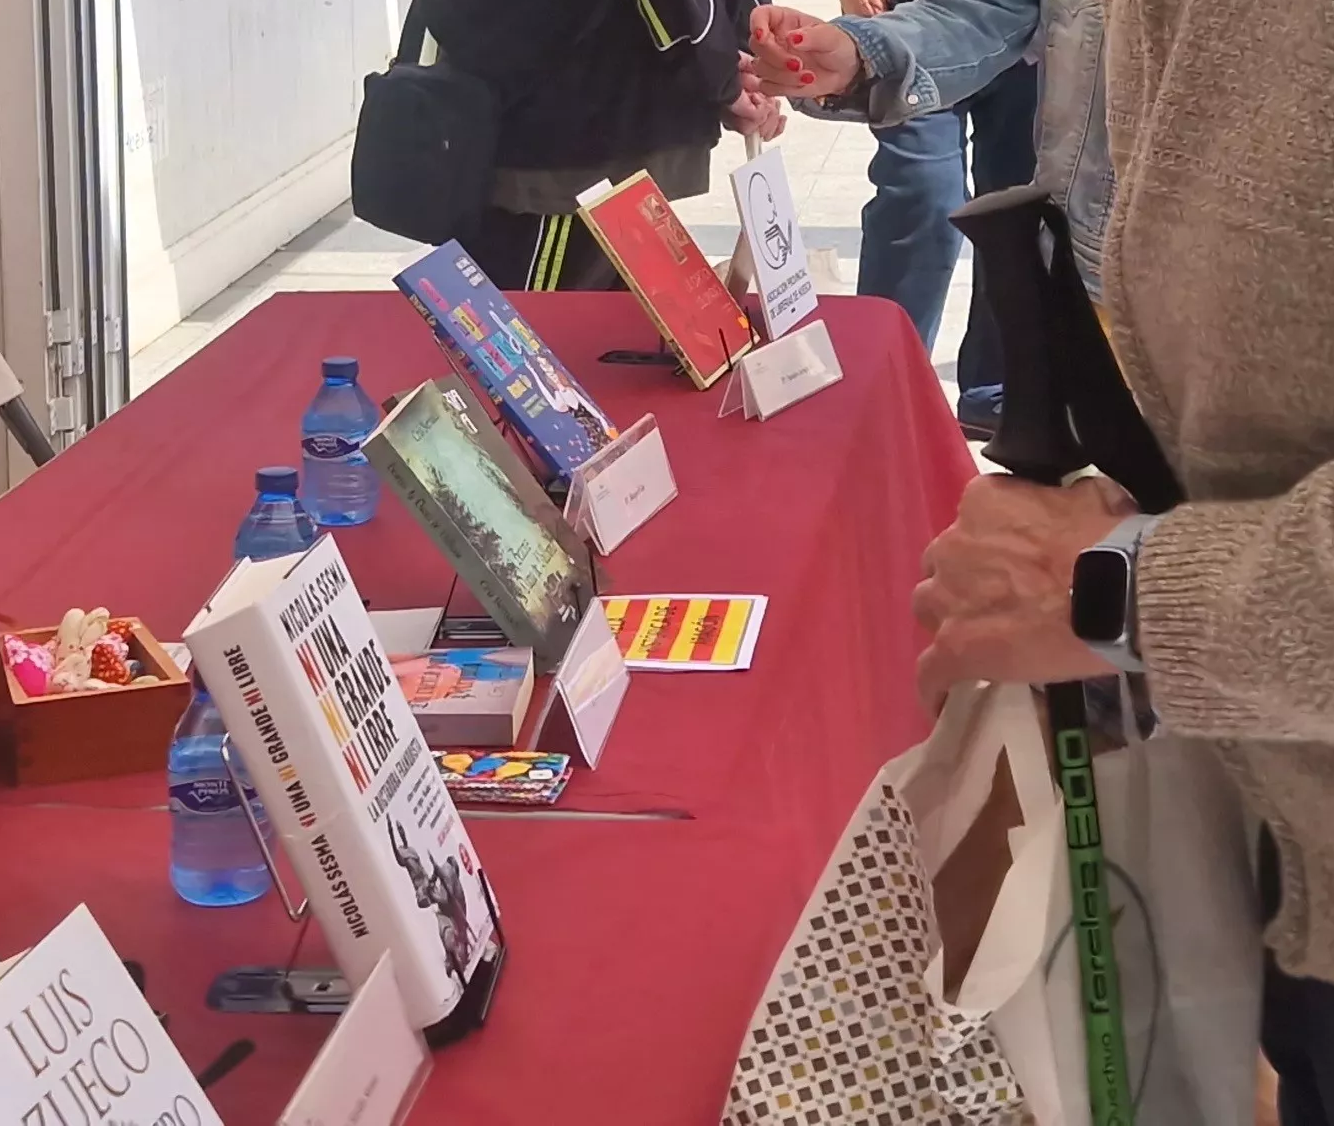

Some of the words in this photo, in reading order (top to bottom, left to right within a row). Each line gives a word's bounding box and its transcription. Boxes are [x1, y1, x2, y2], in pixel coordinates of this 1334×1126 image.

[279, 582, 323, 643] NICOLÁS
[316, 558, 348, 605] SESMA
[223, 644, 257, 695] LIBRE
[295, 638, 328, 697] NI
[310, 613, 352, 679] UNA
[243, 689, 264, 708] NI
[334, 638, 392, 730] GRANDE
[250, 701, 290, 764] GRANDE
[319, 689, 351, 748] NI
[355, 700, 399, 777] LIBRE
[278, 763, 299, 782] NI
[285, 780, 312, 816] UNA
[342, 740, 372, 795] NI
[1055, 727, 1101, 850] 300
[310, 833, 344, 881] SESMA
[325, 877, 370, 940] NICOLÁS
[1079, 860, 1109, 1014] forclaz
[5, 968, 94, 1078] LUIS
